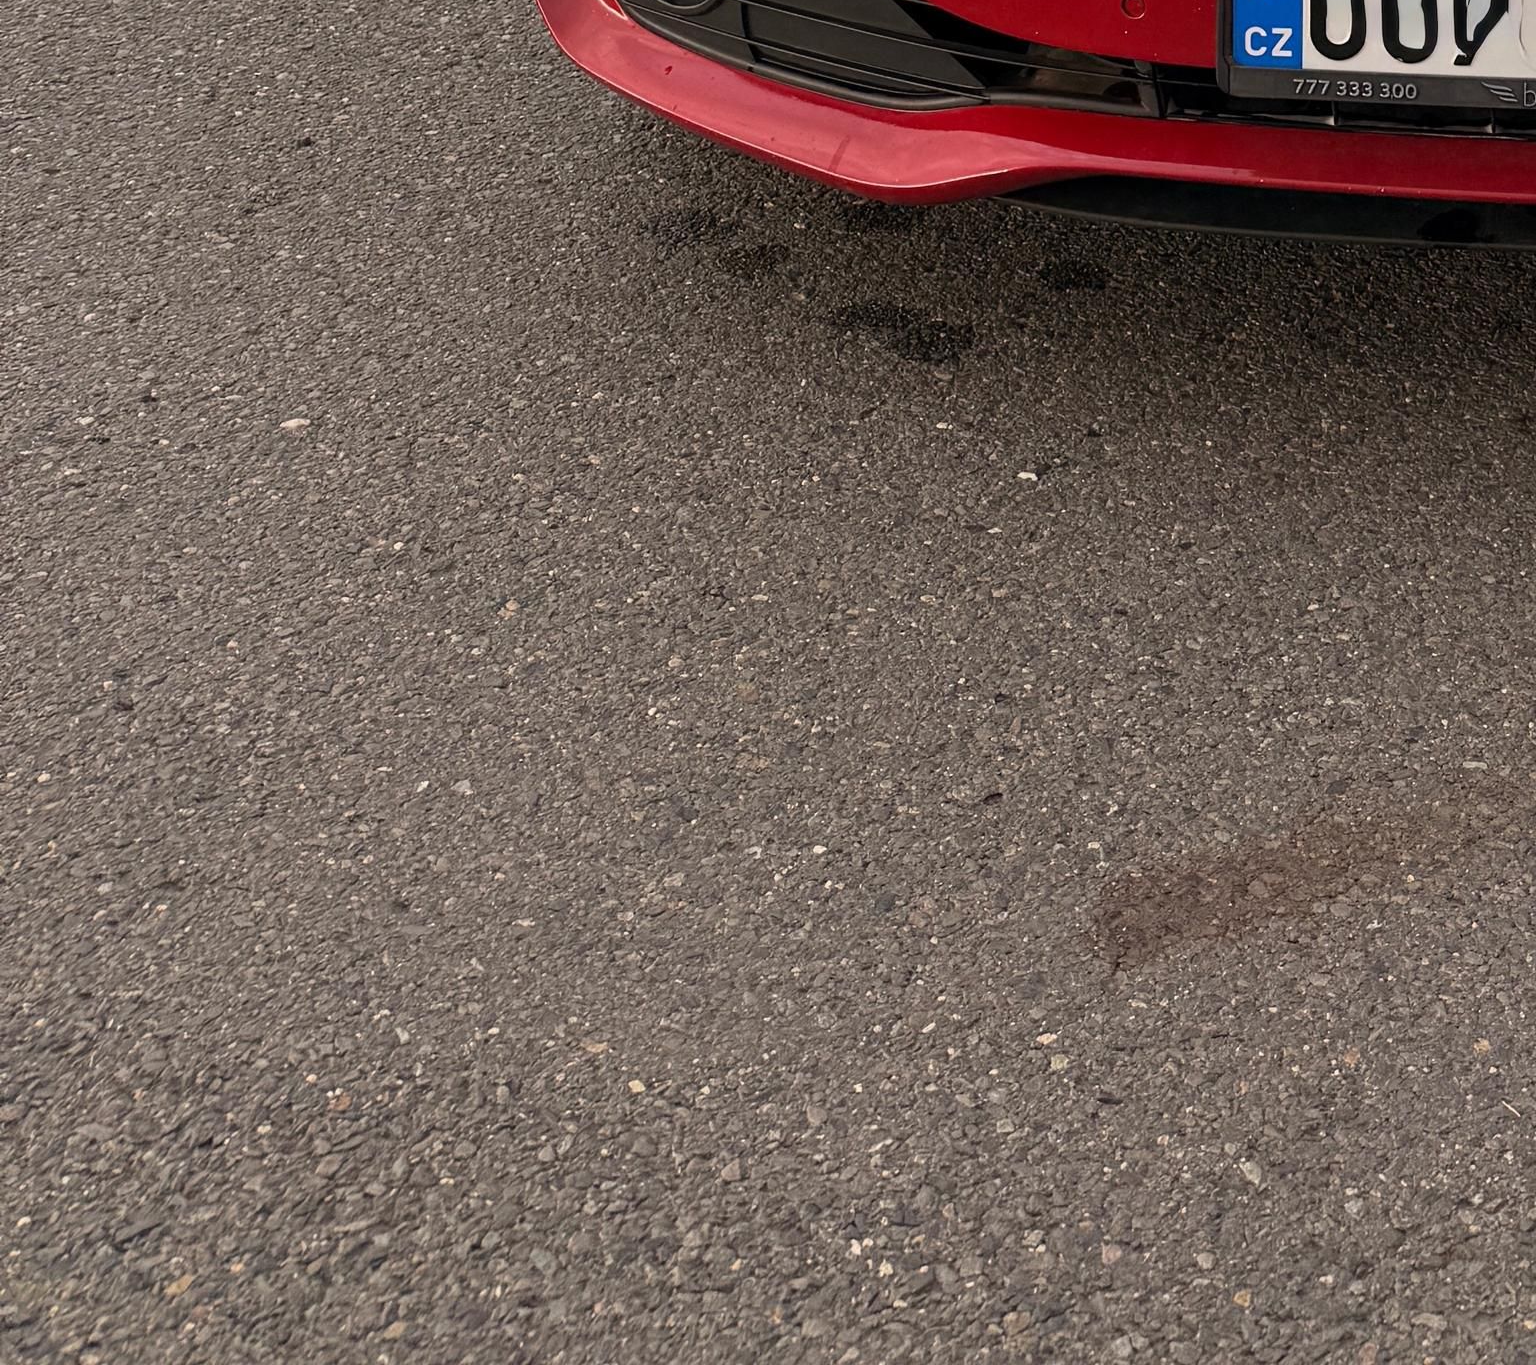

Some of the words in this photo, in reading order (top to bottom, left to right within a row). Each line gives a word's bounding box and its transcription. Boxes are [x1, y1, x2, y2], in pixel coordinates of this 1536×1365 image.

[1244, 26, 1293, 58] CZ
[1293, 78, 1330, 95] 777
[1336, 80, 1373, 97] 333
[1379, 82, 1417, 100] 300
